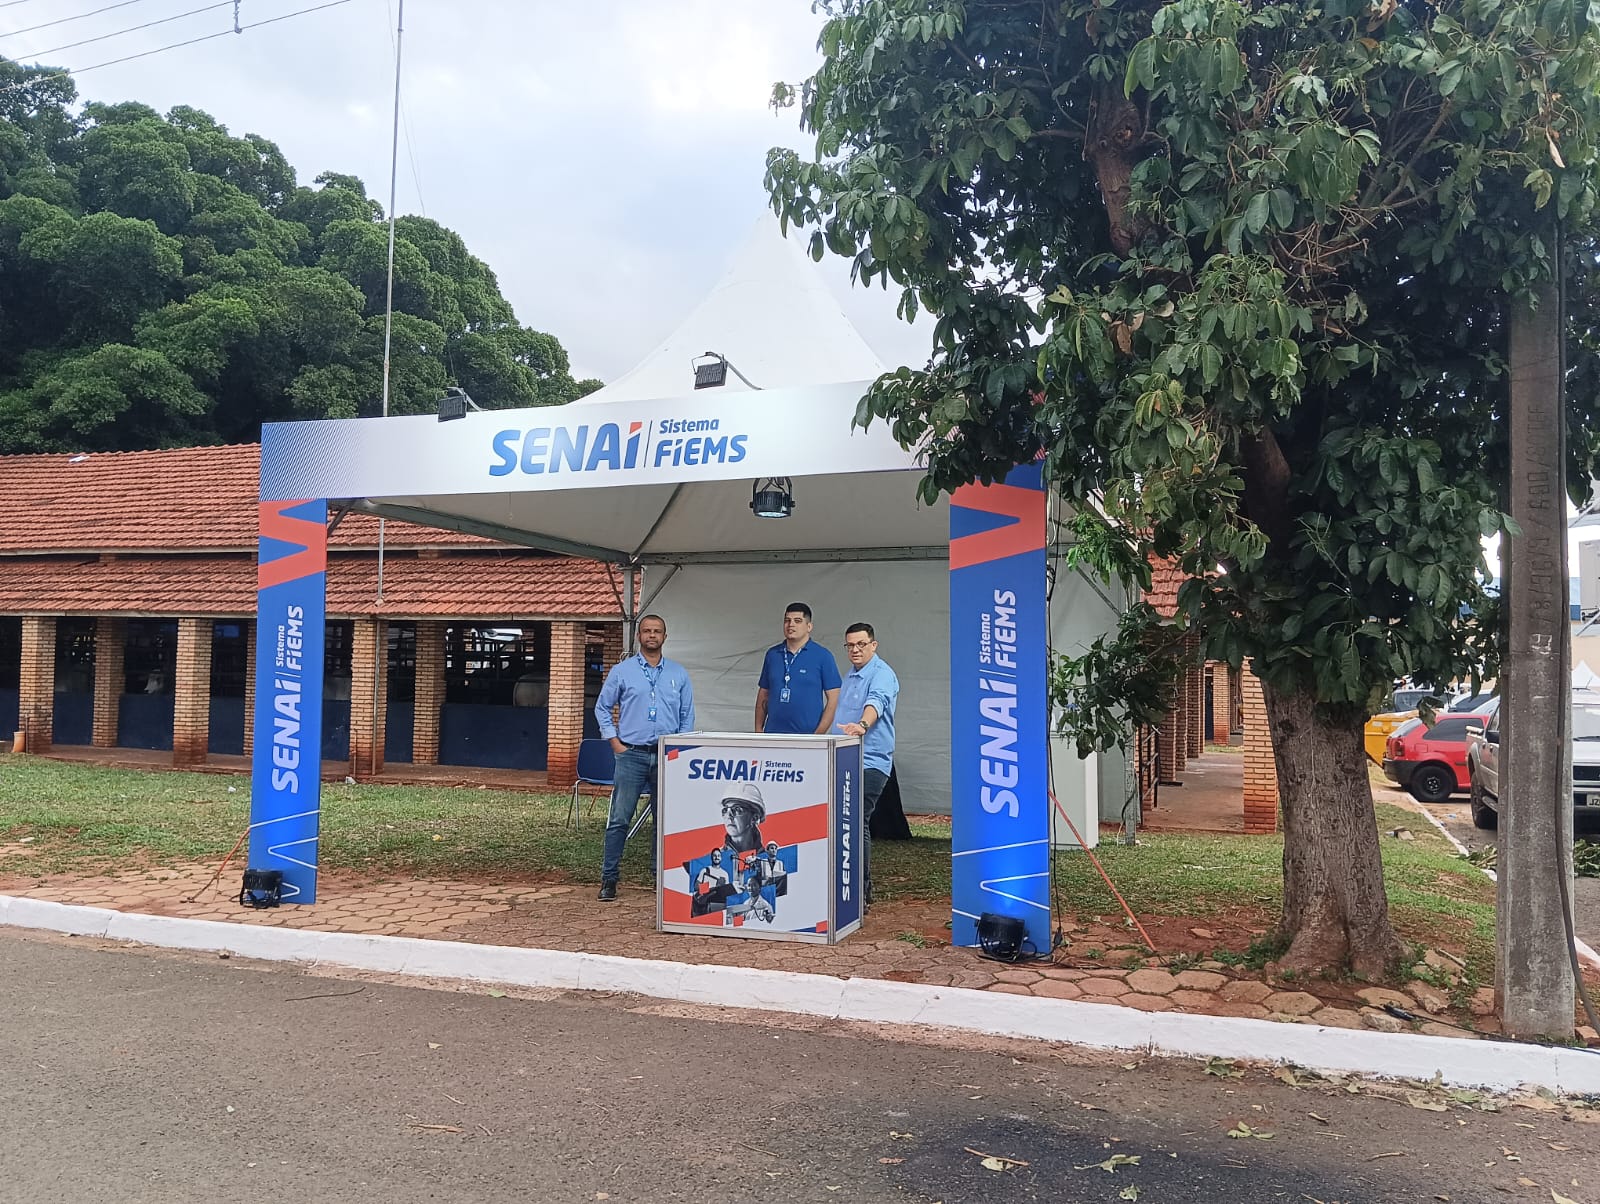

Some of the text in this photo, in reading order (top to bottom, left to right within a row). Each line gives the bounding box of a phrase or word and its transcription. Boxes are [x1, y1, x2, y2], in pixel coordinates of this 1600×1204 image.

[659, 418, 719, 434] Sistema
[276, 625, 285, 667] Sistema
[980, 613, 990, 664] Sistema
[765, 760, 792, 768] Sistema
